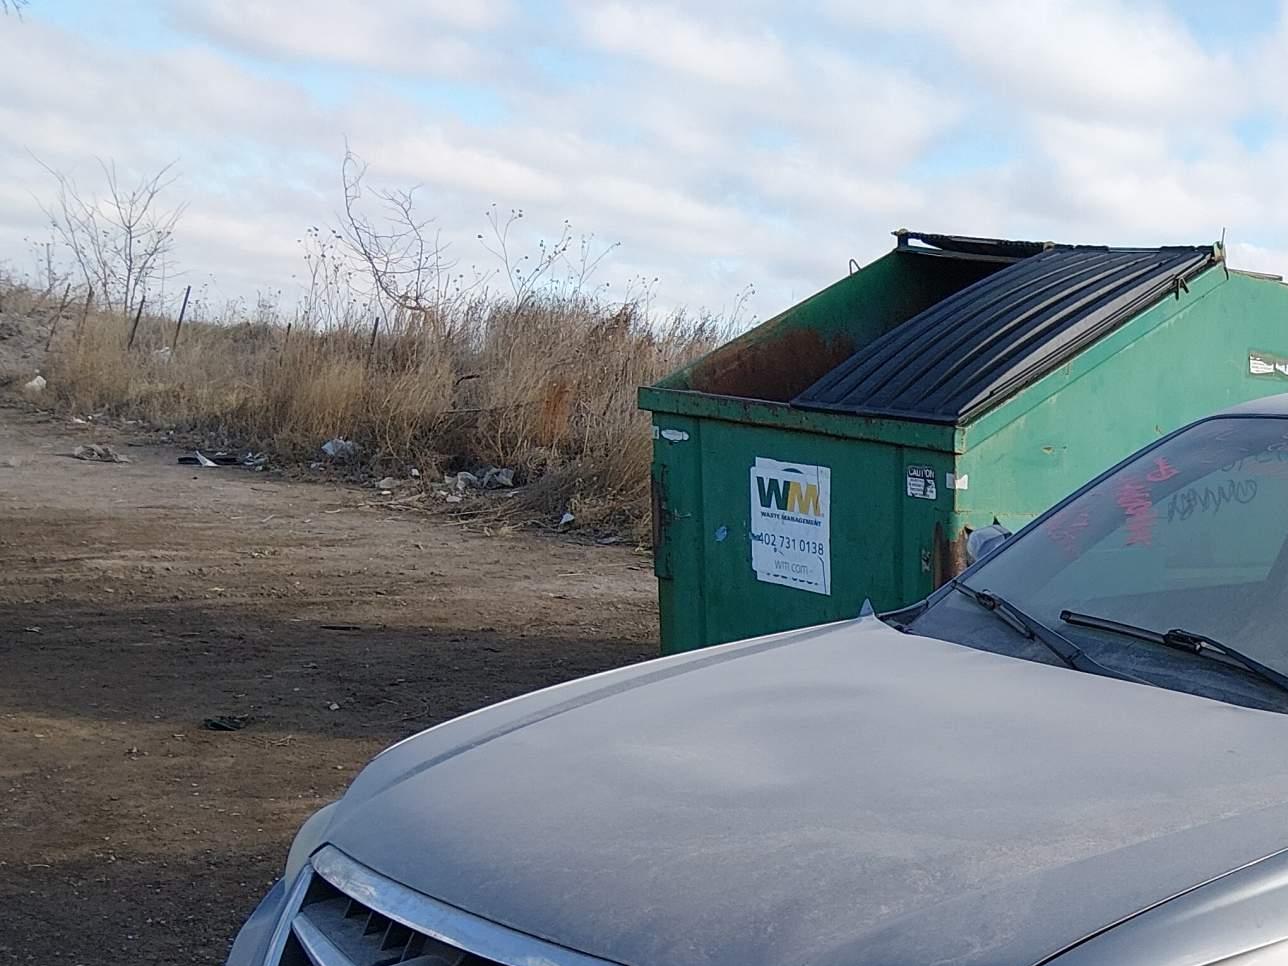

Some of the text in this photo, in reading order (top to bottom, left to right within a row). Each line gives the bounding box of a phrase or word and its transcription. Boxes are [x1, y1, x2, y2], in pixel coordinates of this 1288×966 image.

[908, 468, 935, 478] CAUTON
[757, 476, 824, 517] WM
[760, 511, 823, 527] WASTE MANAGEMENT
[759, 531, 824, 556] 402 731 0138
